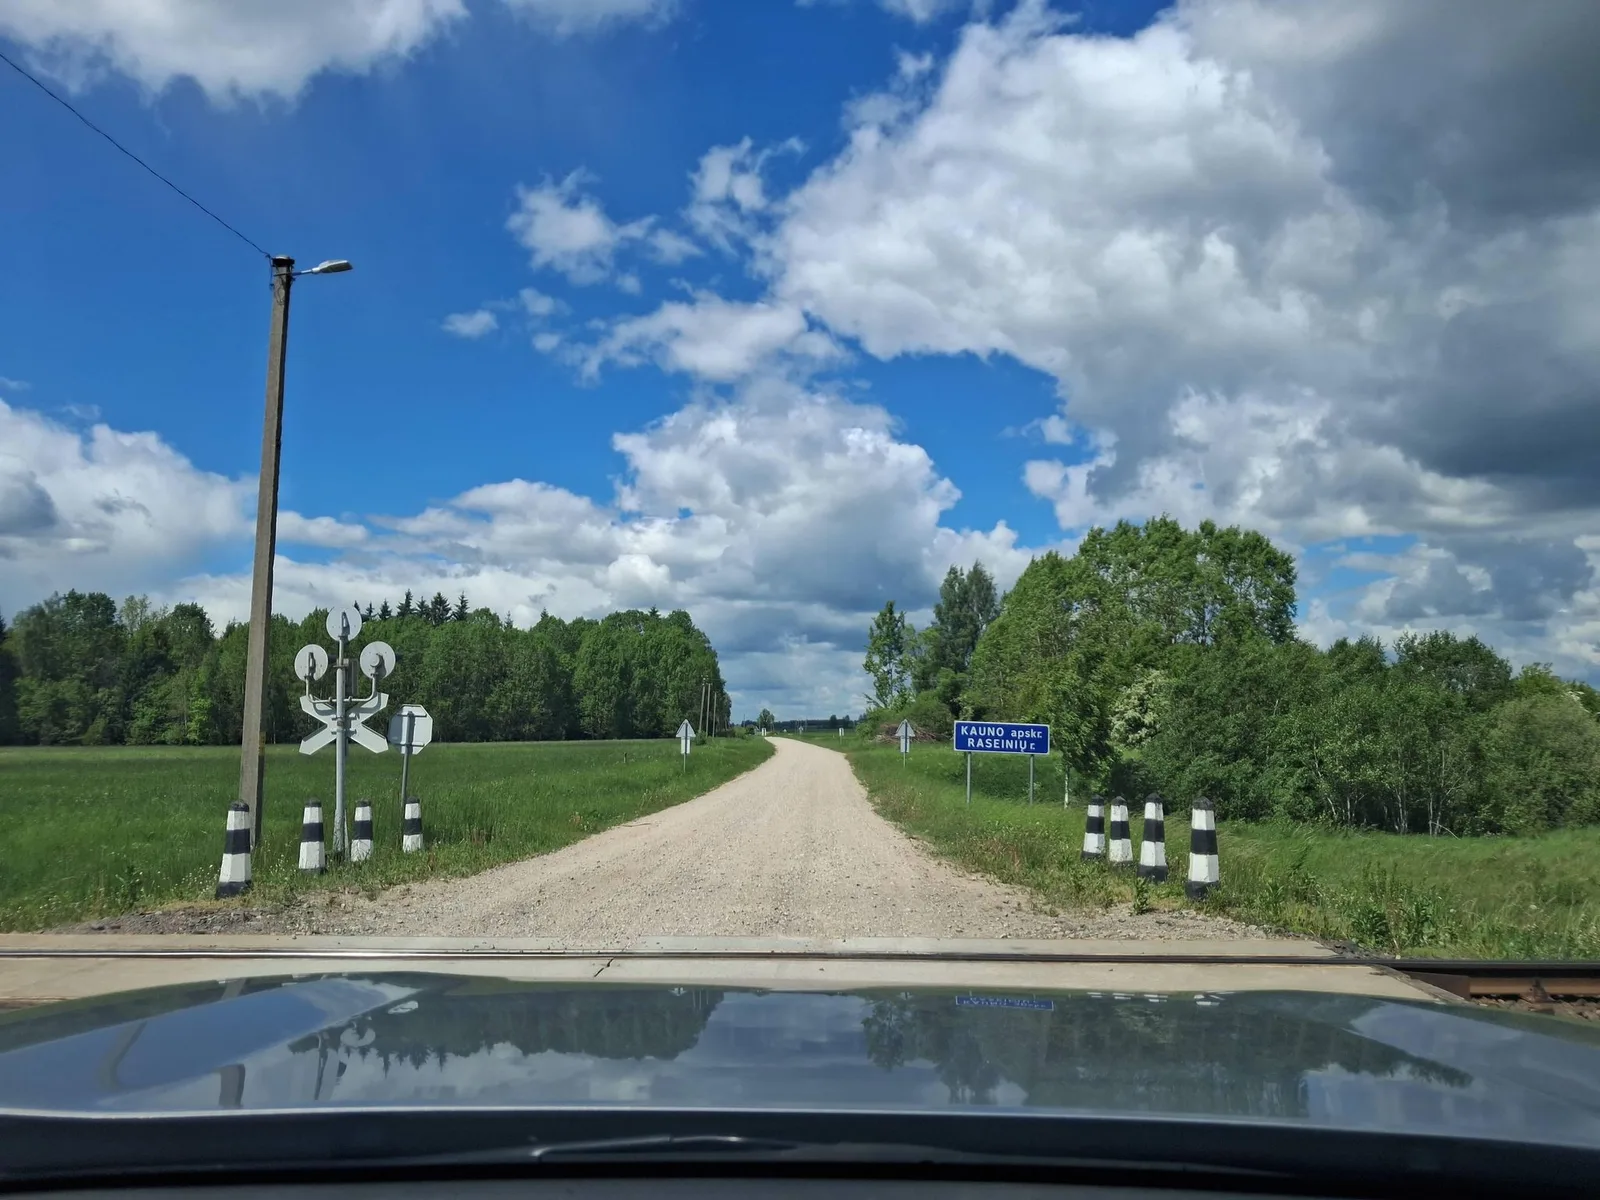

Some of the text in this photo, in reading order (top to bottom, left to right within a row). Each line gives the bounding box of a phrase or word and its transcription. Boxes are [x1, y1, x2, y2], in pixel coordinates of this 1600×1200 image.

[961, 726, 1042, 739] KAUNO apskr.
[967, 738, 1027, 752] RASEINIŲ
